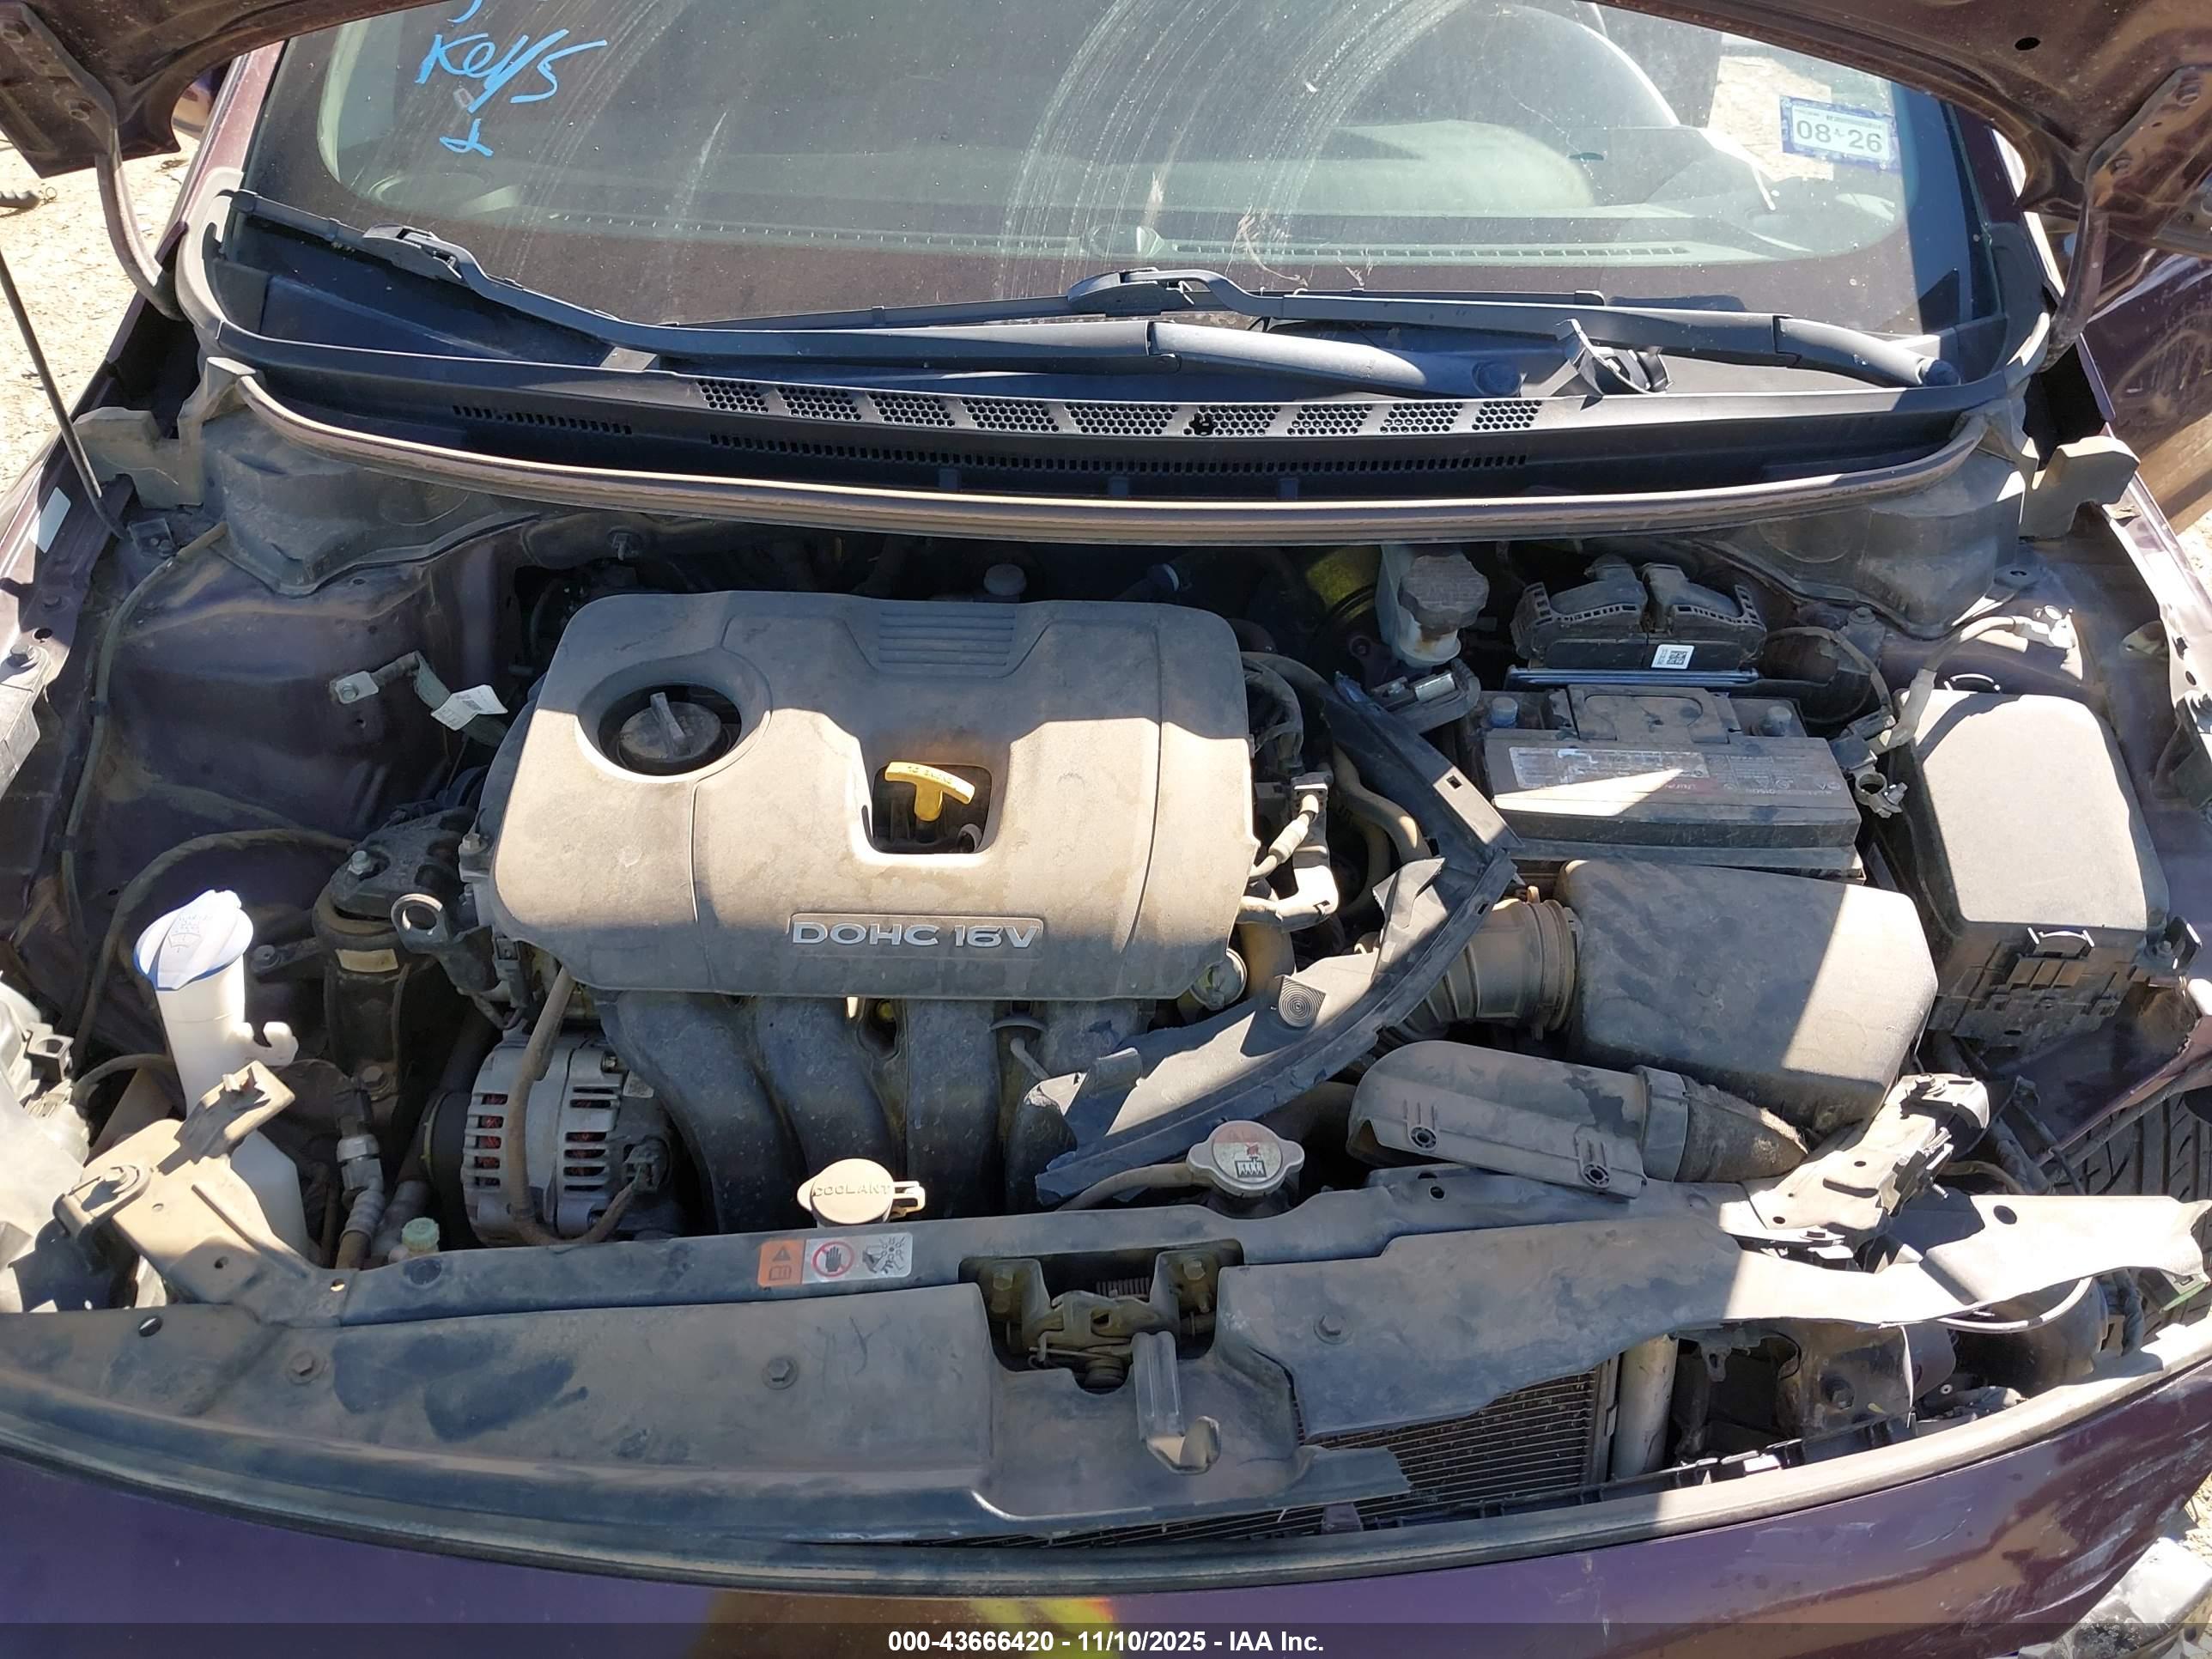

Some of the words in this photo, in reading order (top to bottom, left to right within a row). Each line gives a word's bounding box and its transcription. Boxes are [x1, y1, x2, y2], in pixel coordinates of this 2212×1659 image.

[1797, 120, 1832, 143] 08
[1848, 130, 1882, 153] 26
[792, 921, 940, 946] DOHC
[954, 925, 1038, 948] 16V
[814, 1182, 890, 1197] COOLANT
